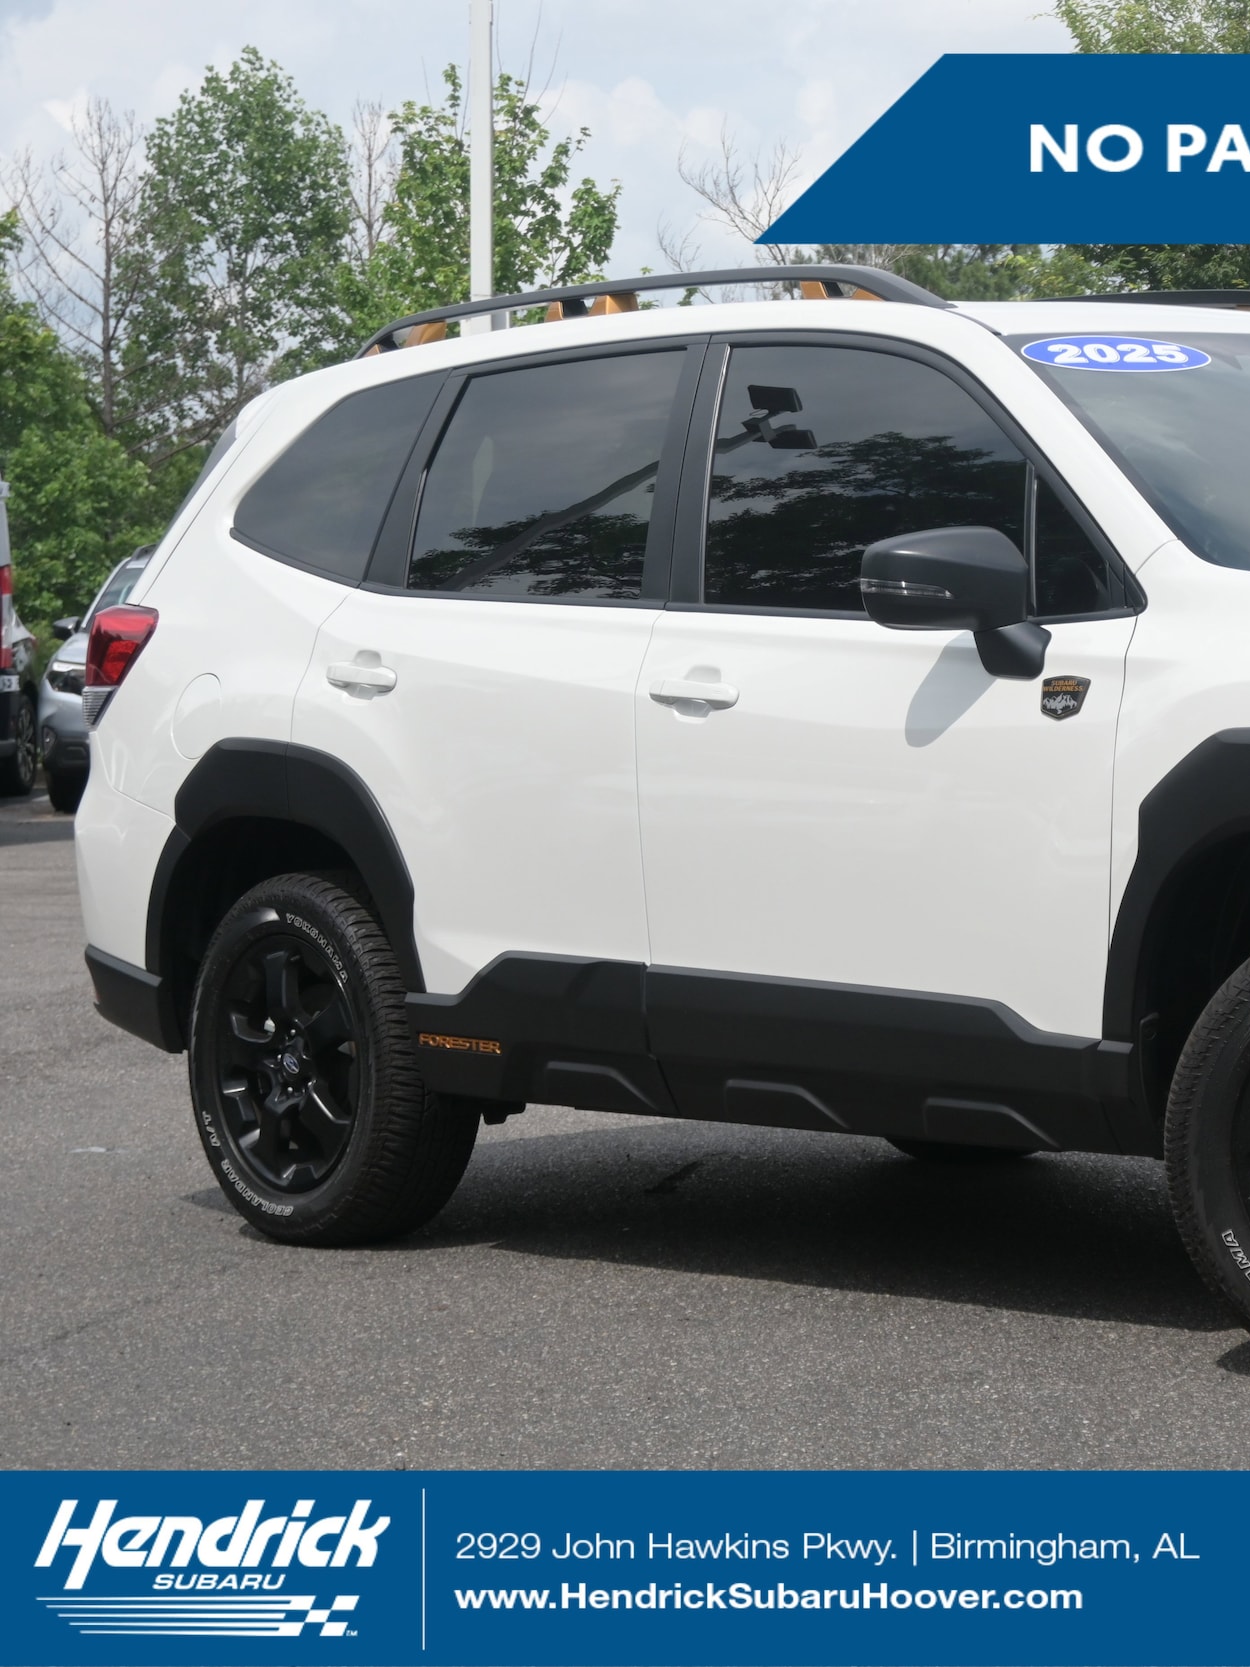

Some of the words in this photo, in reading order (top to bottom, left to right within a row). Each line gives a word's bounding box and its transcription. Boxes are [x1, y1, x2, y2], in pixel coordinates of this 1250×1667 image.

[1047, 343, 1188, 363] 2025
[286, 913, 348, 983] YOKOHAMA
[419, 1032, 501, 1054] FORESTER
